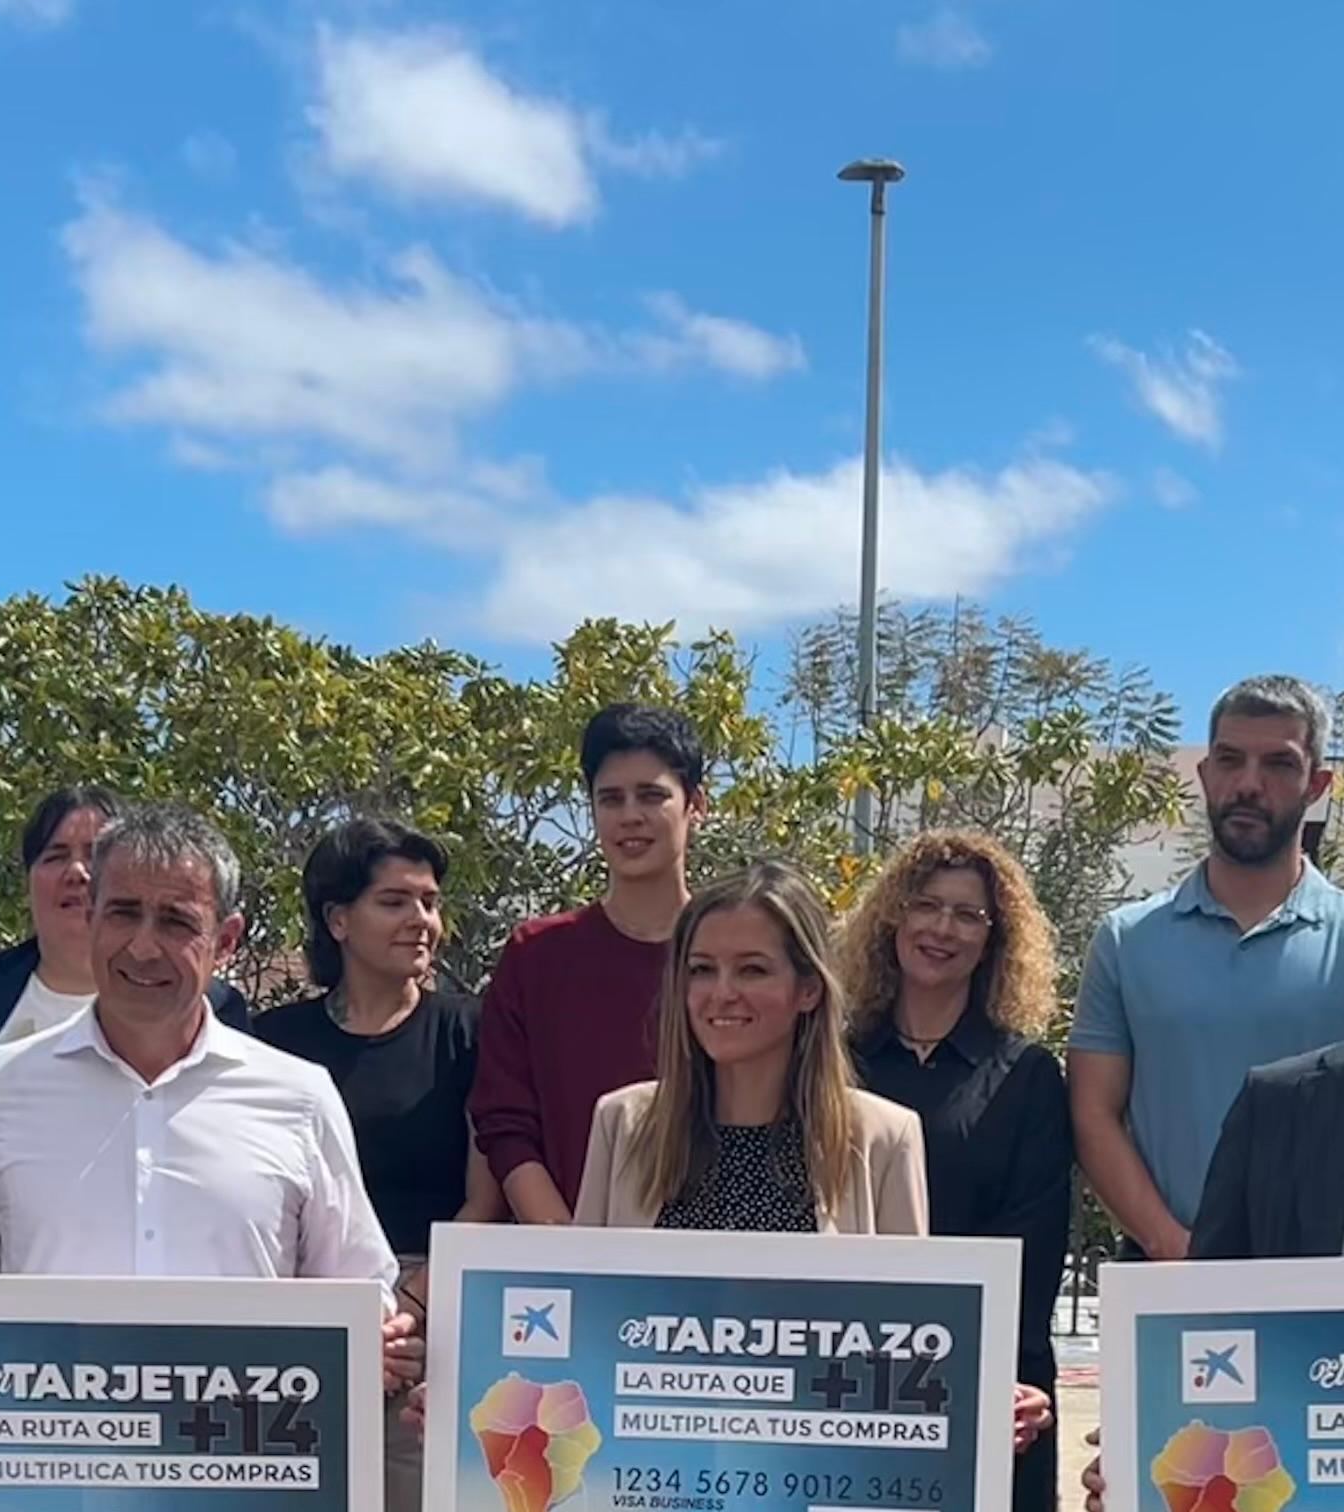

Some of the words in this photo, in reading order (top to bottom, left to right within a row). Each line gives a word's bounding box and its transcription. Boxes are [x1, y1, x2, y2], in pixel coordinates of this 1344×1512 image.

[646, 1315, 952, 1361] TARJETAZO
[3, 1363, 320, 1402] TARJETAZO
[623, 1371, 652, 1389] LA
[660, 1372, 725, 1391] RUTA
[733, 1374, 784, 1396] QUE
[811, 1351, 948, 1413] +14
[22, 1419, 90, 1438] RUTA
[98, 1420, 151, 1440] QUE
[179, 1395, 319, 1454] +14
[622, 1414, 760, 1435] MULTIPLICA
[767, 1418, 812, 1437] TUS
[819, 1420, 940, 1440] COMPRAS
[136, 1463, 182, 1480] TUS
[189, 1463, 312, 1482] COMPRAS
[613, 1467, 681, 1493] 1234
[696, 1470, 768, 1496] 5678
[784, 1473, 852, 1499] 9012
[867, 1477, 943, 1501] 3456
[613, 1495, 646, 1508] VISA
[650, 1497, 725, 1511] BUSINESS
